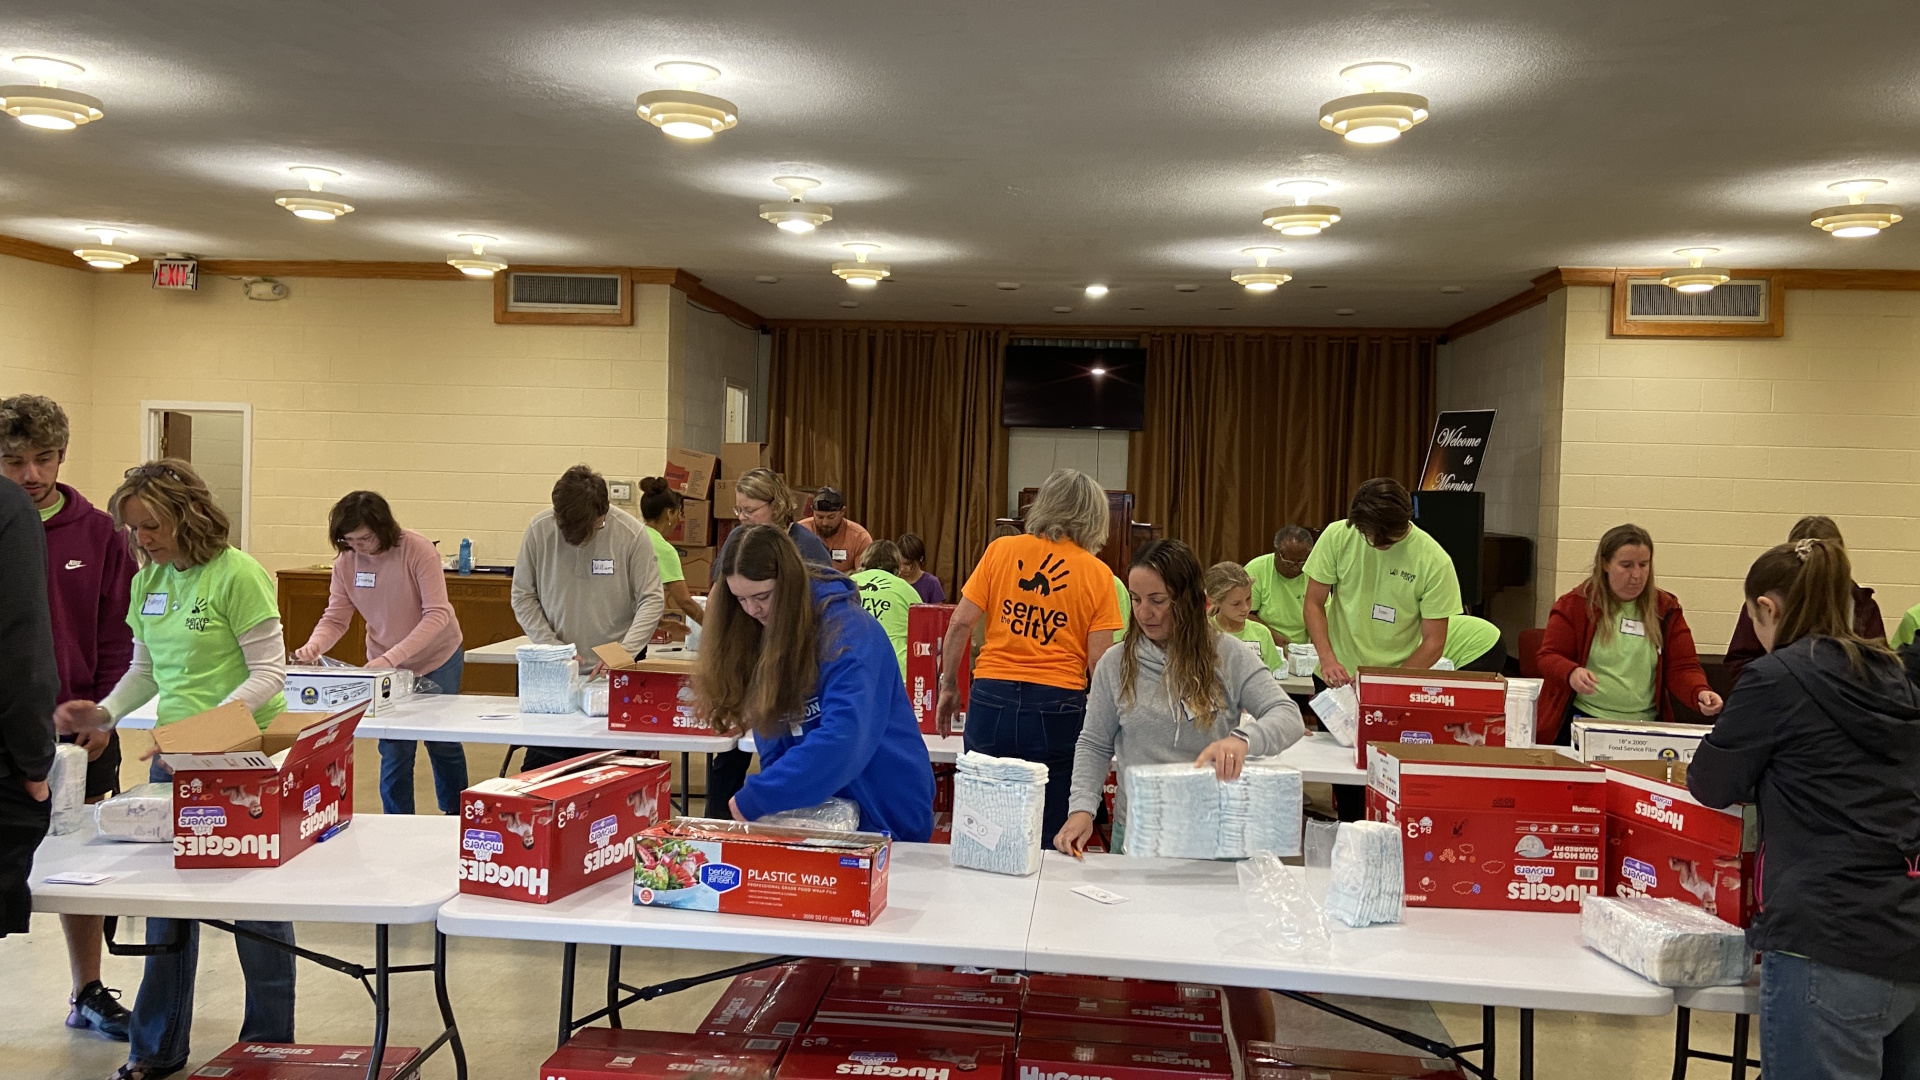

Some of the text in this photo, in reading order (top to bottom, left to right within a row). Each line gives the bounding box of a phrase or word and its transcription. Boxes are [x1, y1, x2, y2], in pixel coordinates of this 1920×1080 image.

[158, 264, 188, 286] EXIT
[1437, 425, 1481, 447] Welcome
[1464, 455, 1473, 465] to
[1432, 473, 1473, 492] Morning
[862, 597, 891, 611] rve
[186, 617, 209, 625] serve
[1001, 615, 1011, 624] the
[1003, 599, 1068, 628] serve
[614, 679, 621, 688] 3
[914, 676, 924, 722] HUGGIES
[1410, 693, 1455, 707] HUGGIES
[1365, 715, 1373, 725] 3
[180, 785, 190, 798] 3
[283, 781, 288, 797] 3
[465, 805, 484, 819] 84 3
[558, 811, 566, 828] 3
[1635, 801, 1684, 831] HUGGIES
[180, 817, 226, 826] movers
[300, 800, 338, 840] HUGGIES
[1407, 822, 1419, 838] 3
[173, 834, 280, 860] HUGGIES
[464, 840, 502, 852] movers
[584, 836, 635, 875] UGGIES
[1579, 852, 1598, 860] OUR
[459, 858, 548, 896] HUGGIES
[708, 867, 736, 878] berkley
[748, 869, 837, 887] PLASTIC WRAP
[1516, 867, 1553, 875] movers
[1623, 867, 1656, 886] movers
[1507, 882, 1598, 907] HUGGIES
[934, 994, 1003, 1004] HUGGIES
[711, 997, 746, 1024] HUGGIES
[1131, 1008, 1204, 1021] HUGGIES
[243, 1045, 314, 1055] HUGGIES
[1132, 1054, 1211, 1068] HUGGIES
[836, 1063, 949, 1080] HUGGIES
